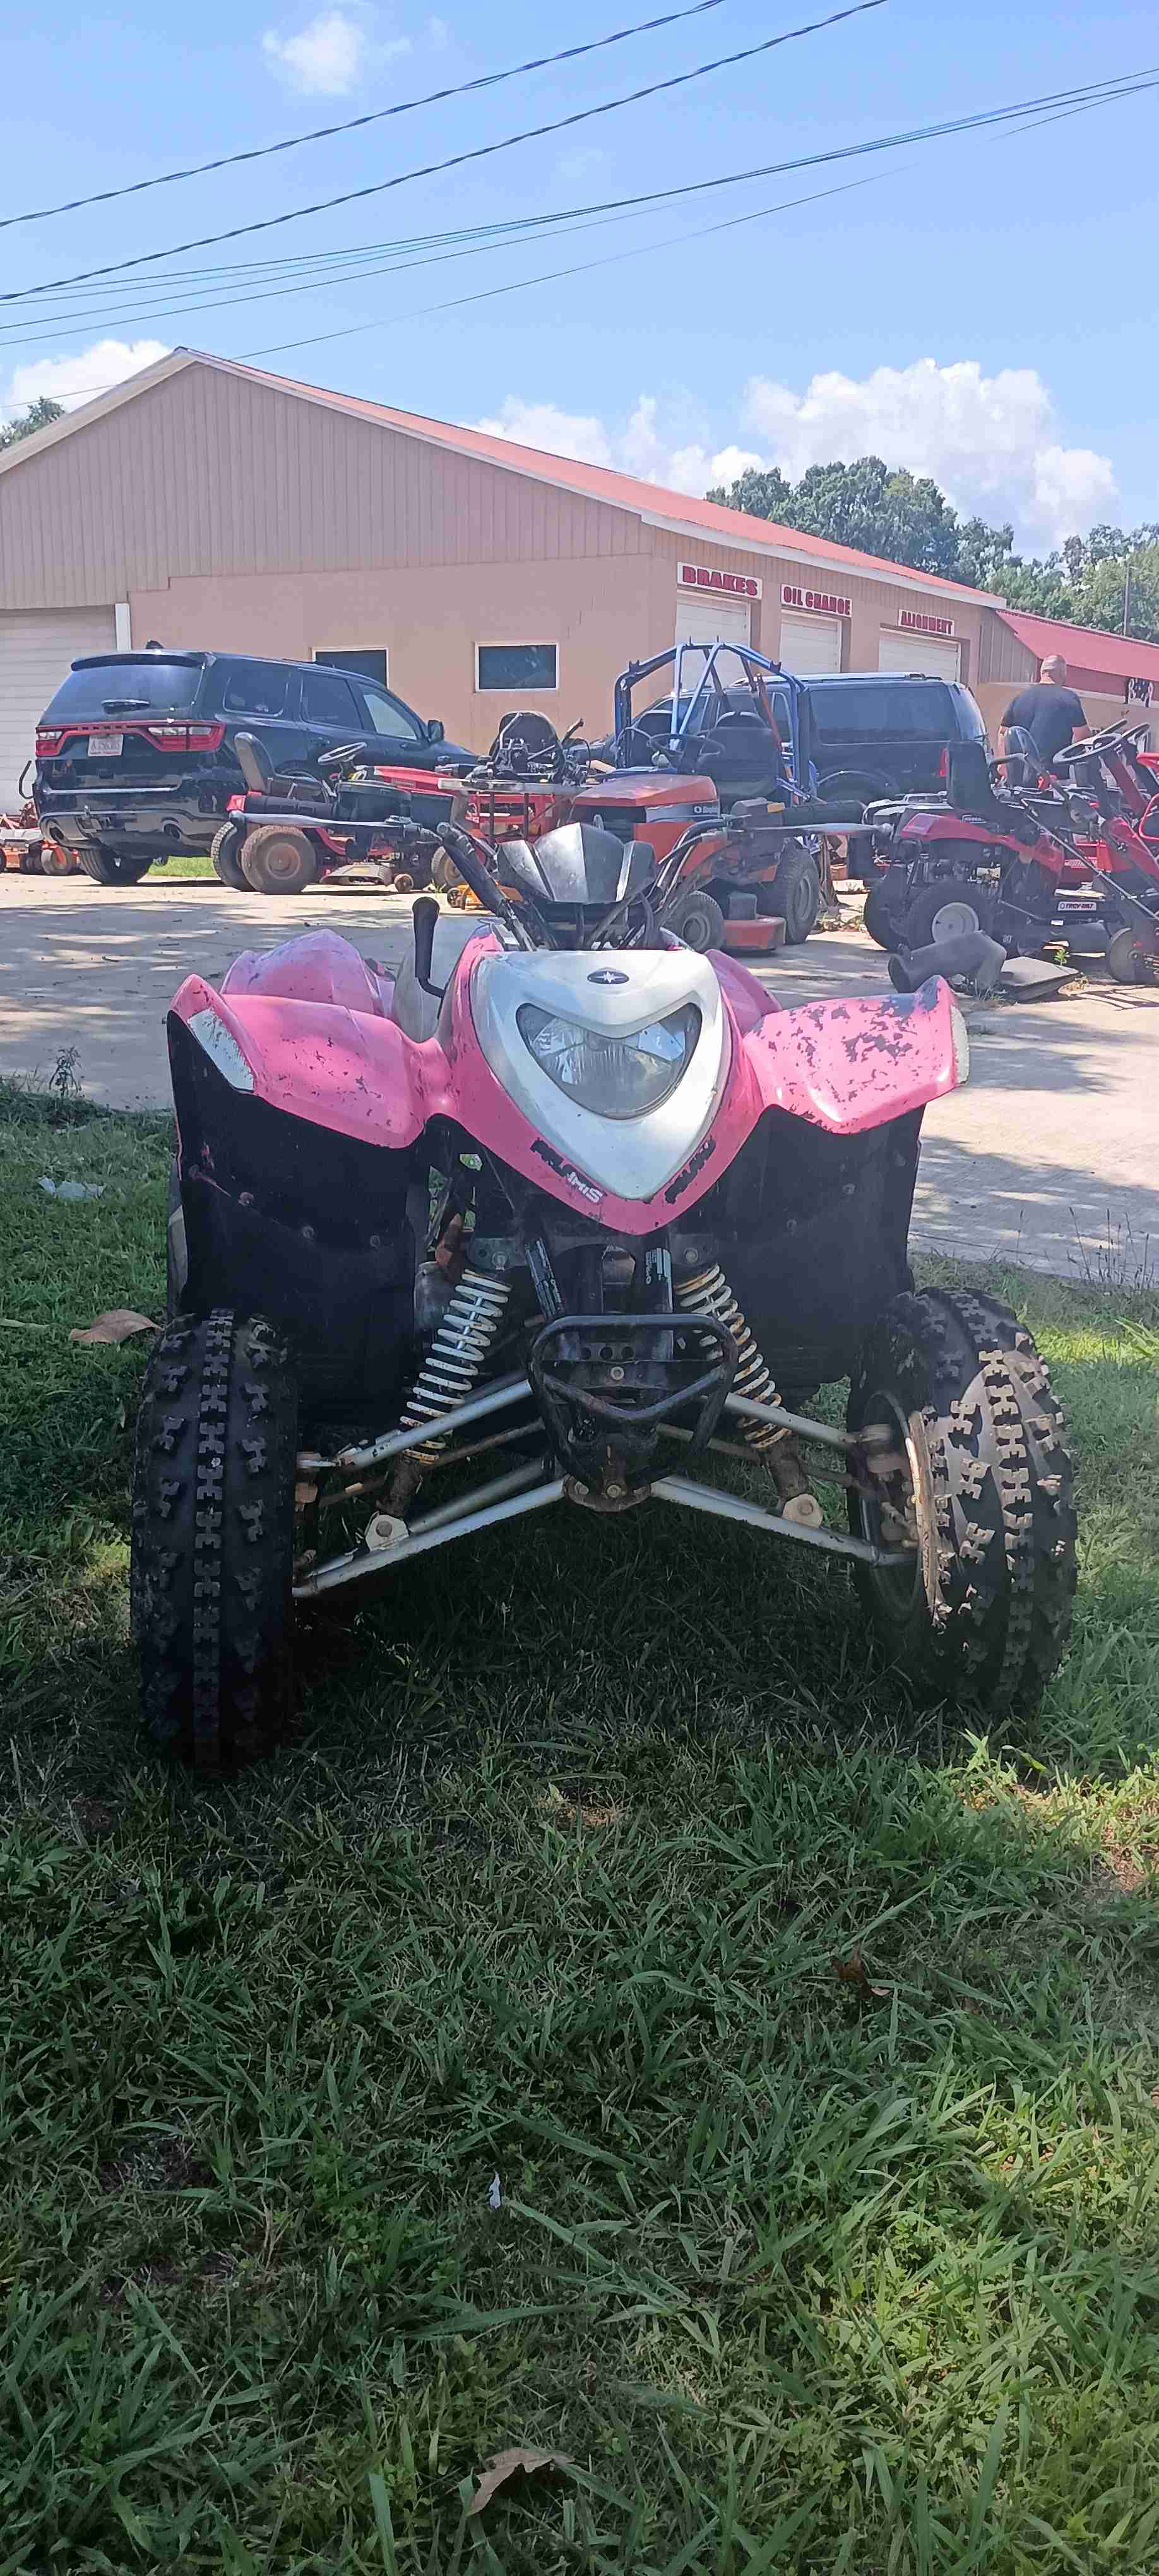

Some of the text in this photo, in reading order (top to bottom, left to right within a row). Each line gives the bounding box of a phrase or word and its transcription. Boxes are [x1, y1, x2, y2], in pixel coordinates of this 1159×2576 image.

[682, 565, 758, 596] BRAKES
[783, 586, 850, 615] OIL CHANGE
[901, 611, 953, 635] ALIGNMENT
